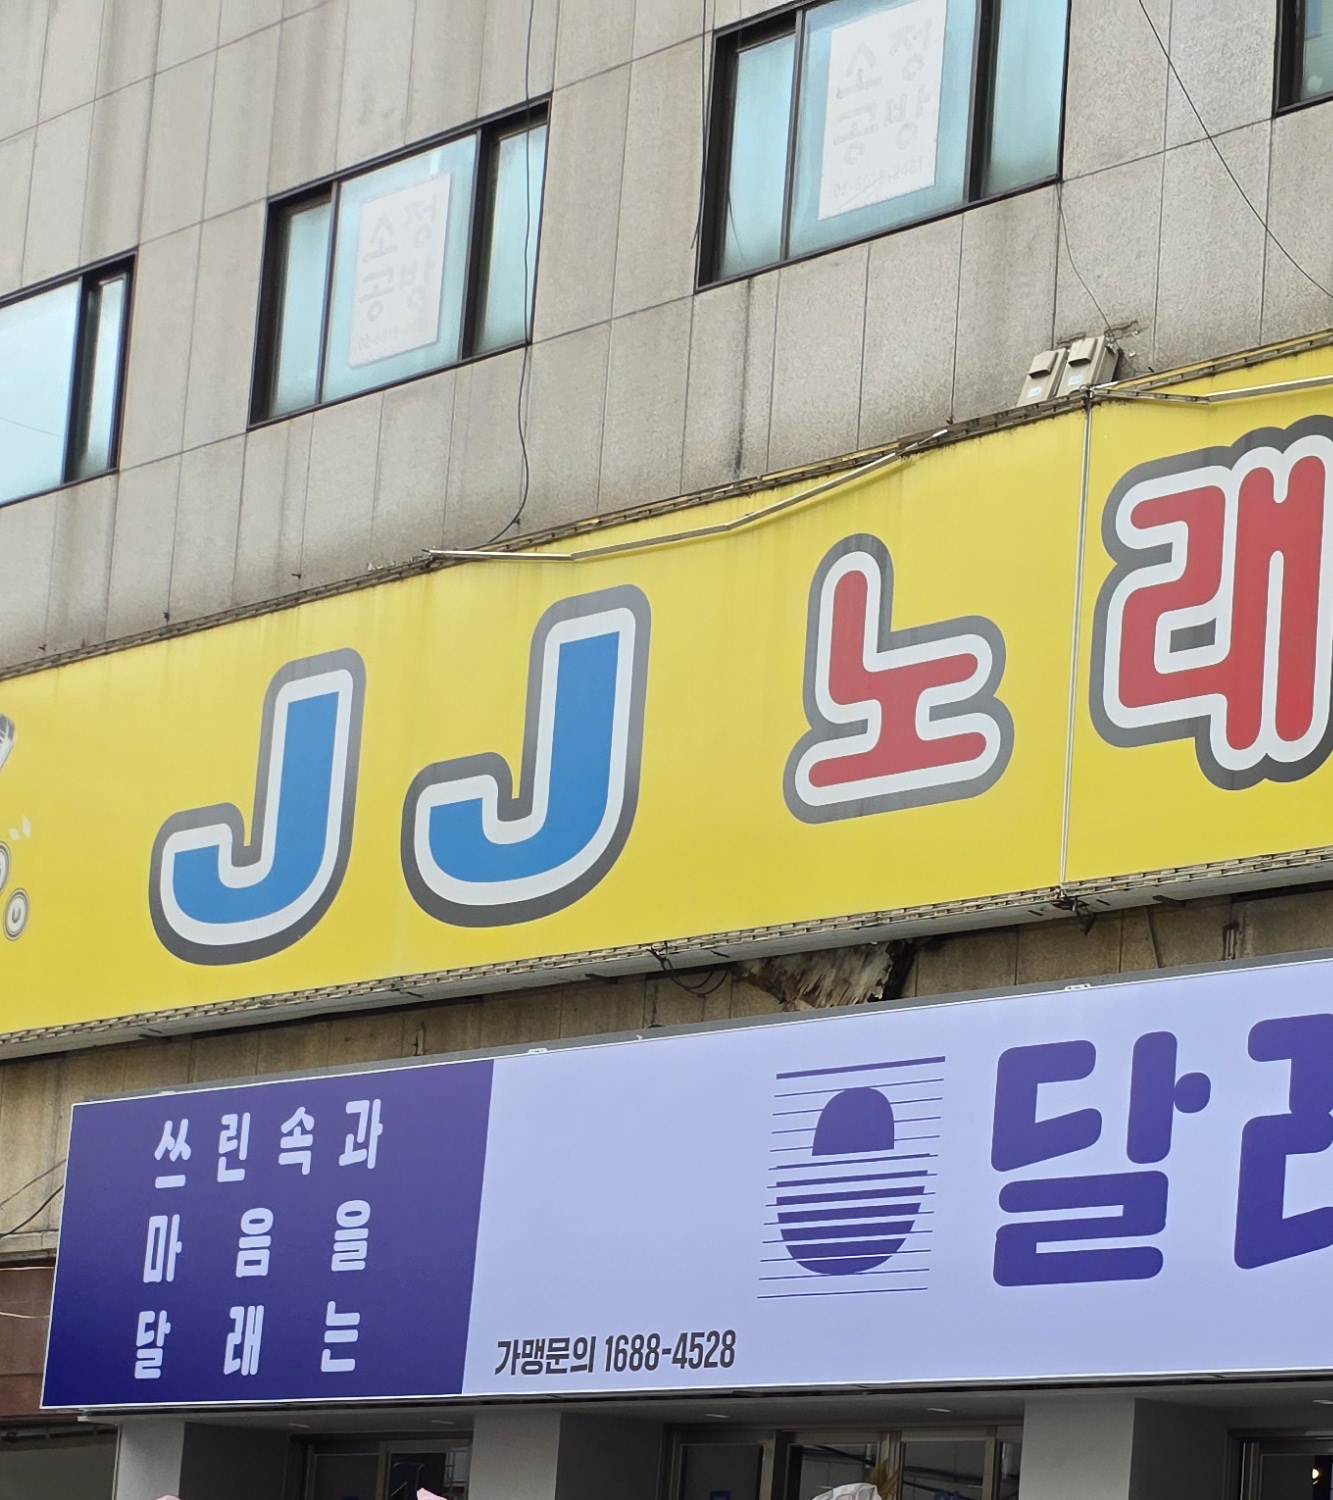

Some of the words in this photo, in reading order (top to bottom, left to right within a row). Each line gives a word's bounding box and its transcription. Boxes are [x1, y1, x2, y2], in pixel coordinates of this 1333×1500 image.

[150, 584, 651, 965] JJ
[143, 1199, 371, 1284] 마음을
[134, 1301, 361, 1380] 달래는
[496, 1335, 595, 1375] 가맹문의
[605, 1329, 736, 1372] 1688-4528
